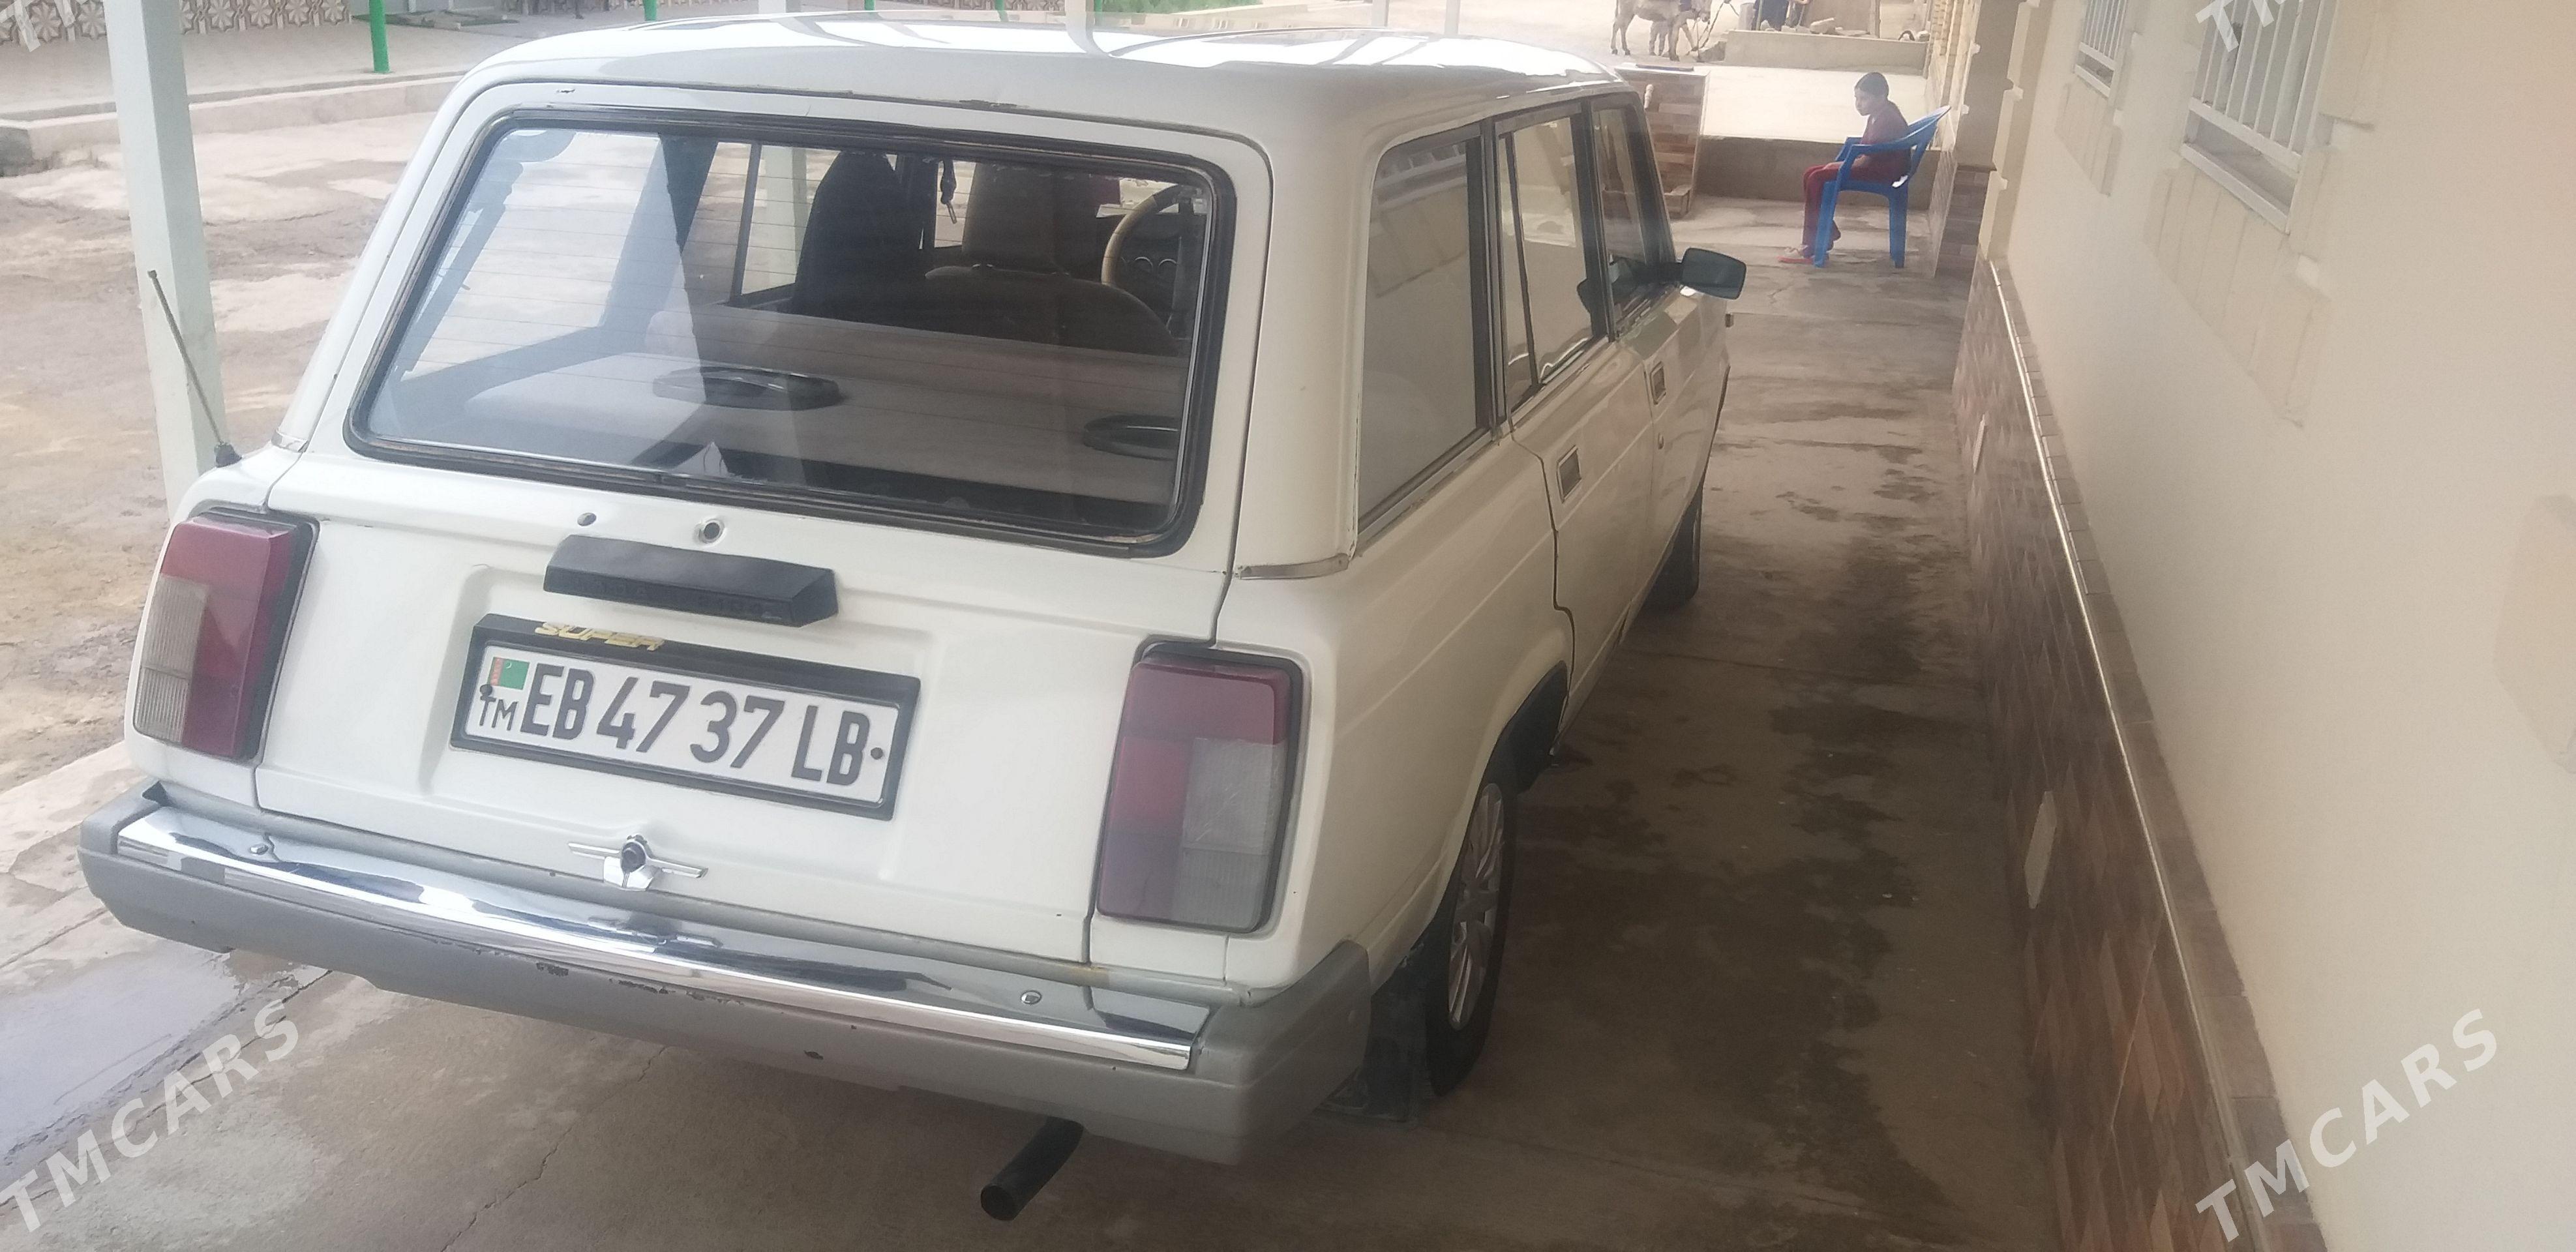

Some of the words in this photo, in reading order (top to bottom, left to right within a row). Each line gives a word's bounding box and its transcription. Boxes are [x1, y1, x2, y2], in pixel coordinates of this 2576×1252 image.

[535, 621, 665, 651] SUPER
[479, 695, 519, 732] TM
[790, 705, 871, 786] LB
